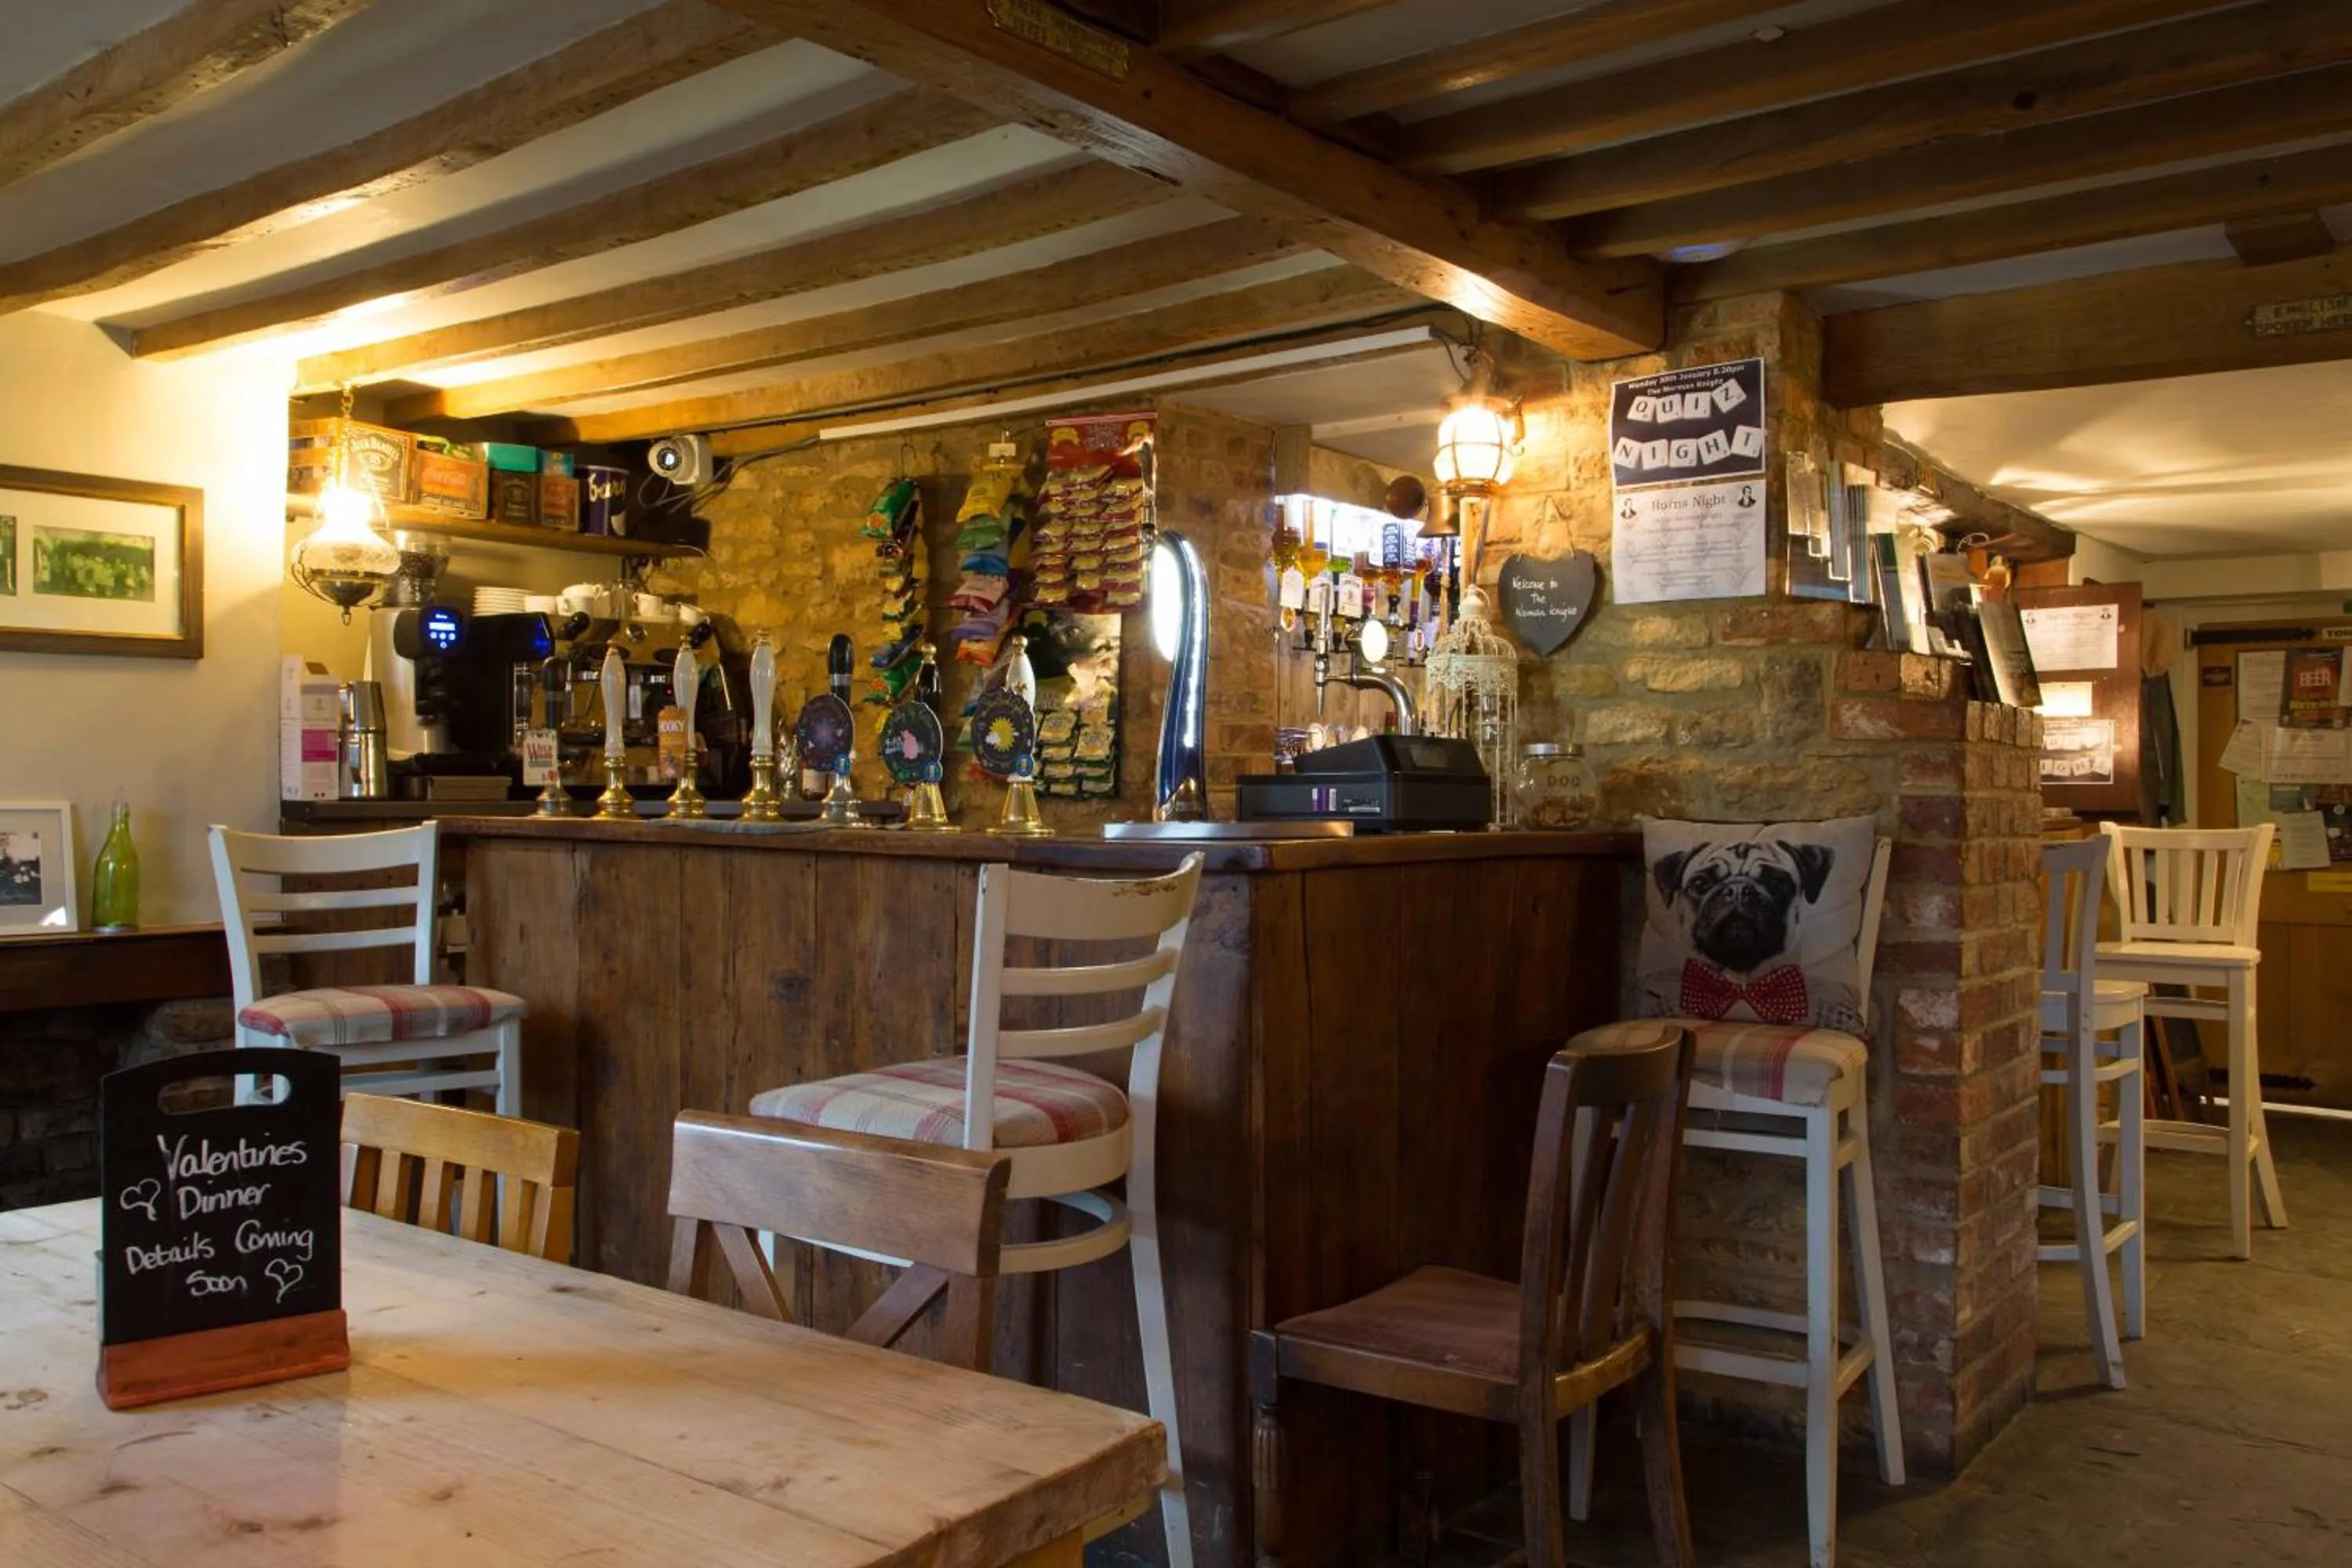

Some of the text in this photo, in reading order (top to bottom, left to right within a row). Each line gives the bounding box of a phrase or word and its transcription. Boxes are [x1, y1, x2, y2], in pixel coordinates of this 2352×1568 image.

[1628, 379, 1657, 390] Monday
[1680, 370, 1711, 380] January
[1647, 387, 1661, 396] The
[1696, 379, 1724, 389] Knight
[1635, 387, 1735, 414] QUIZ
[1619, 432, 1753, 459] NIGHT
[1693, 494, 1726, 510] Night
[1512, 575, 1544, 590] Welcome
[1530, 592, 1547, 604] The
[2299, 670, 2332, 687] BEER
[157, 1131, 308, 1179] Valentines
[177, 1180, 272, 1220] Dinner
[125, 1218, 314, 1274] Details Coming
[186, 1269, 248, 1297] Soon
